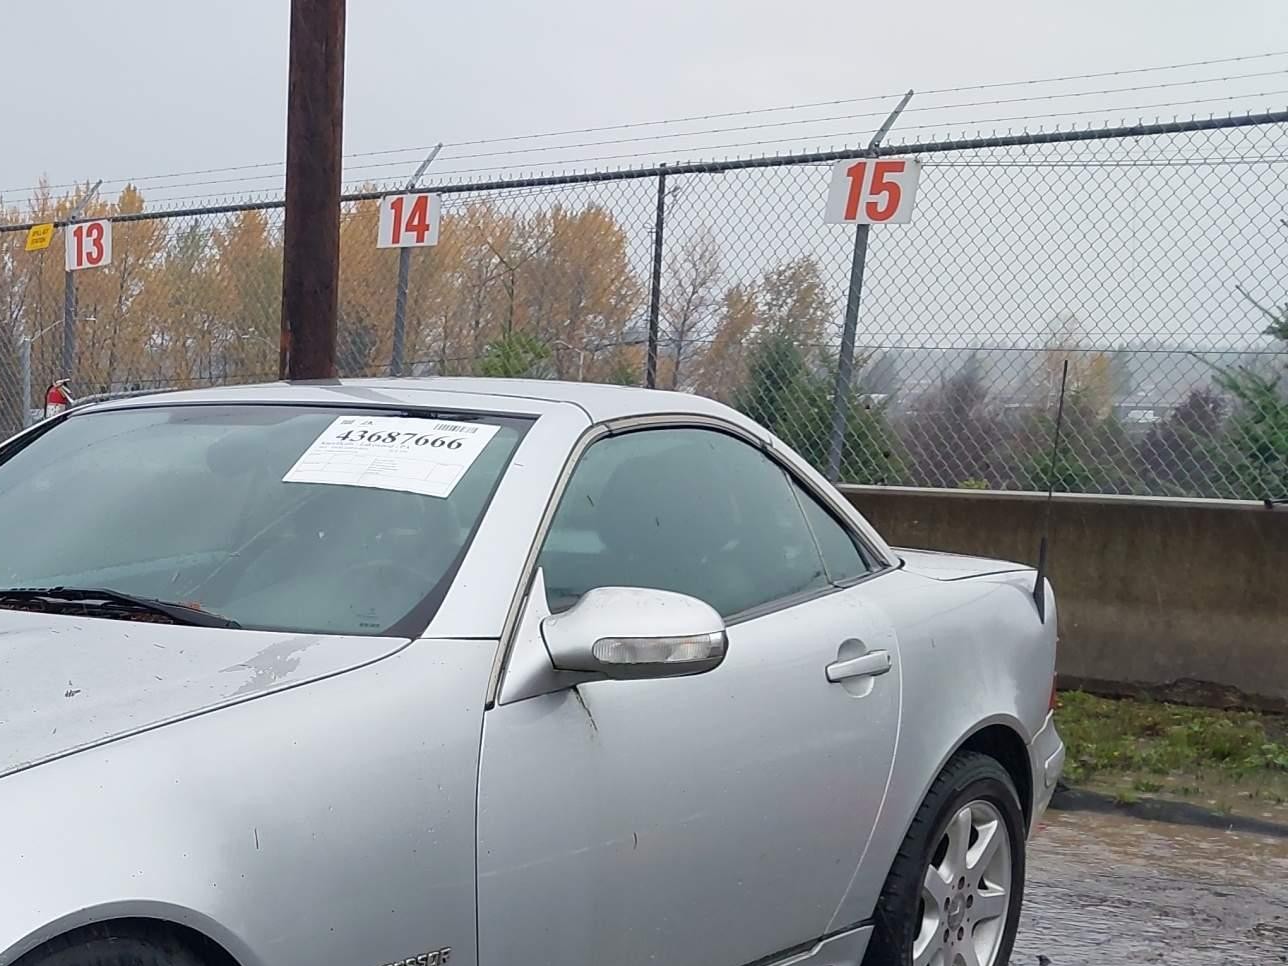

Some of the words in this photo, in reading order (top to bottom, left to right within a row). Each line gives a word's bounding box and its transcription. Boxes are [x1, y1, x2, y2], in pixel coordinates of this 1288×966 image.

[843, 161, 906, 222] 15
[390, 195, 430, 244] 14
[73, 222, 104, 267] 13
[335, 429, 464, 450] 43687666
